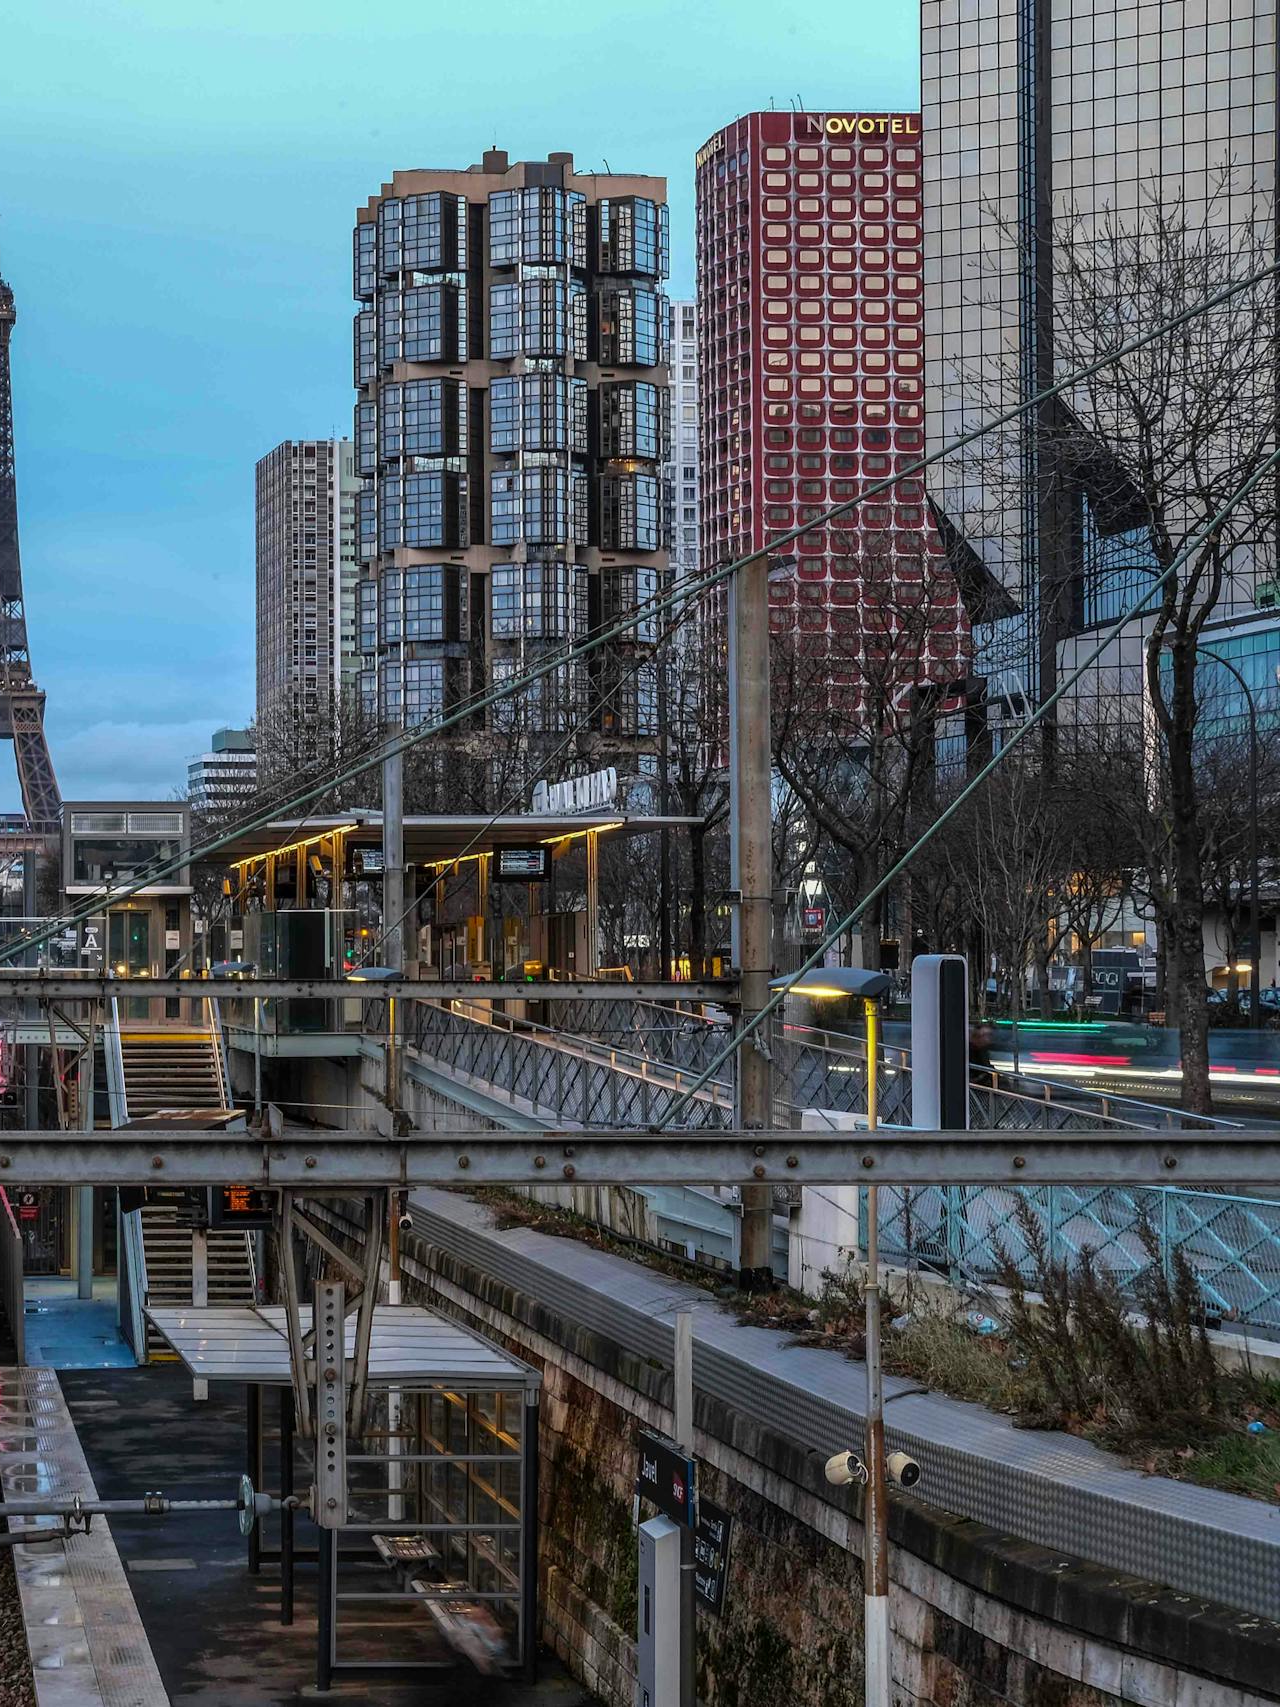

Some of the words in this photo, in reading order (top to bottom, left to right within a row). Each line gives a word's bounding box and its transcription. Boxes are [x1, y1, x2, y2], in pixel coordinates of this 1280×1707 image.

[807, 115, 919, 134] NOVOTEL
[85, 934, 98, 947] A
[641, 1452, 658, 1485] Javel
